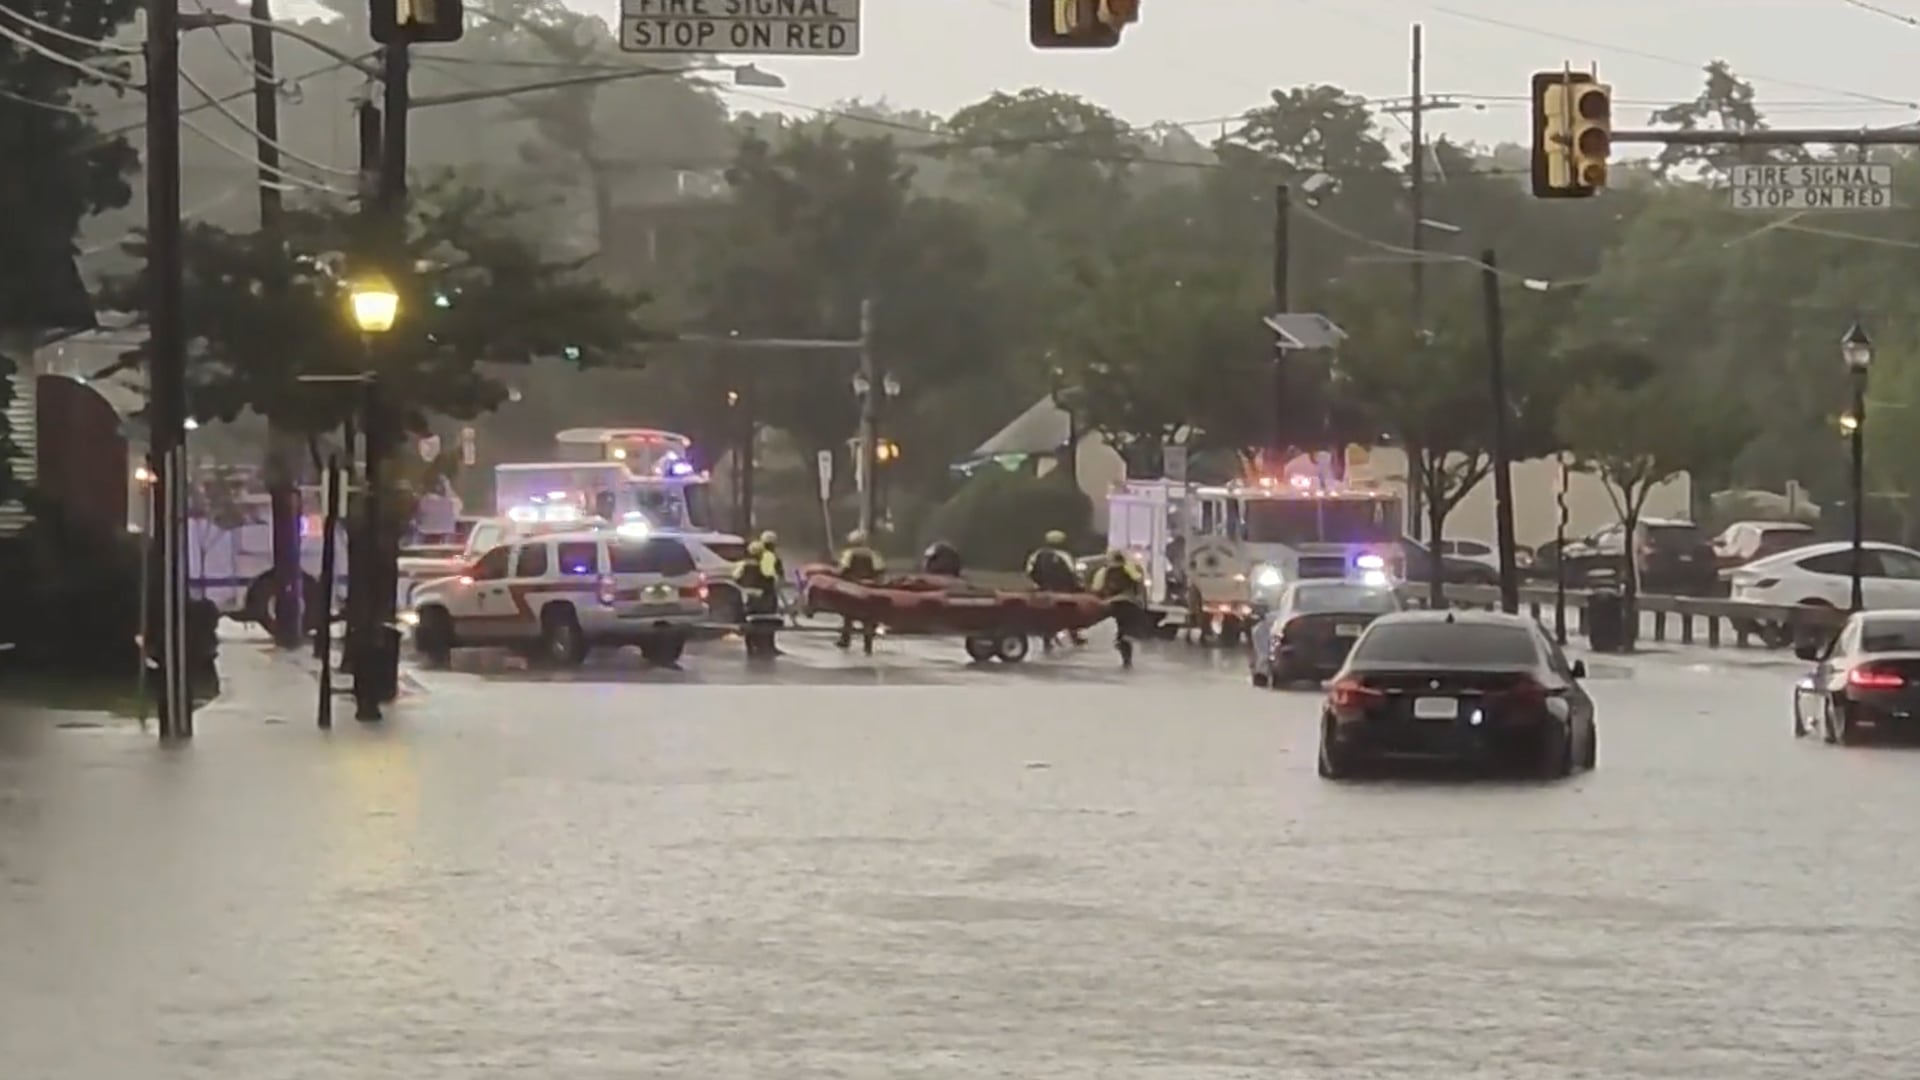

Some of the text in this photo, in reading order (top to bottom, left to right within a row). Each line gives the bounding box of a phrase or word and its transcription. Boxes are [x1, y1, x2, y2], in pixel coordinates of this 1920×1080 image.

[640, 0, 839, 17] FIRE SIGNAL
[635, 21, 846, 49] STOP ON RED
[1746, 167, 1879, 185] FIRE SIGNAL
[1741, 188, 1884, 206] STOP ON RED
